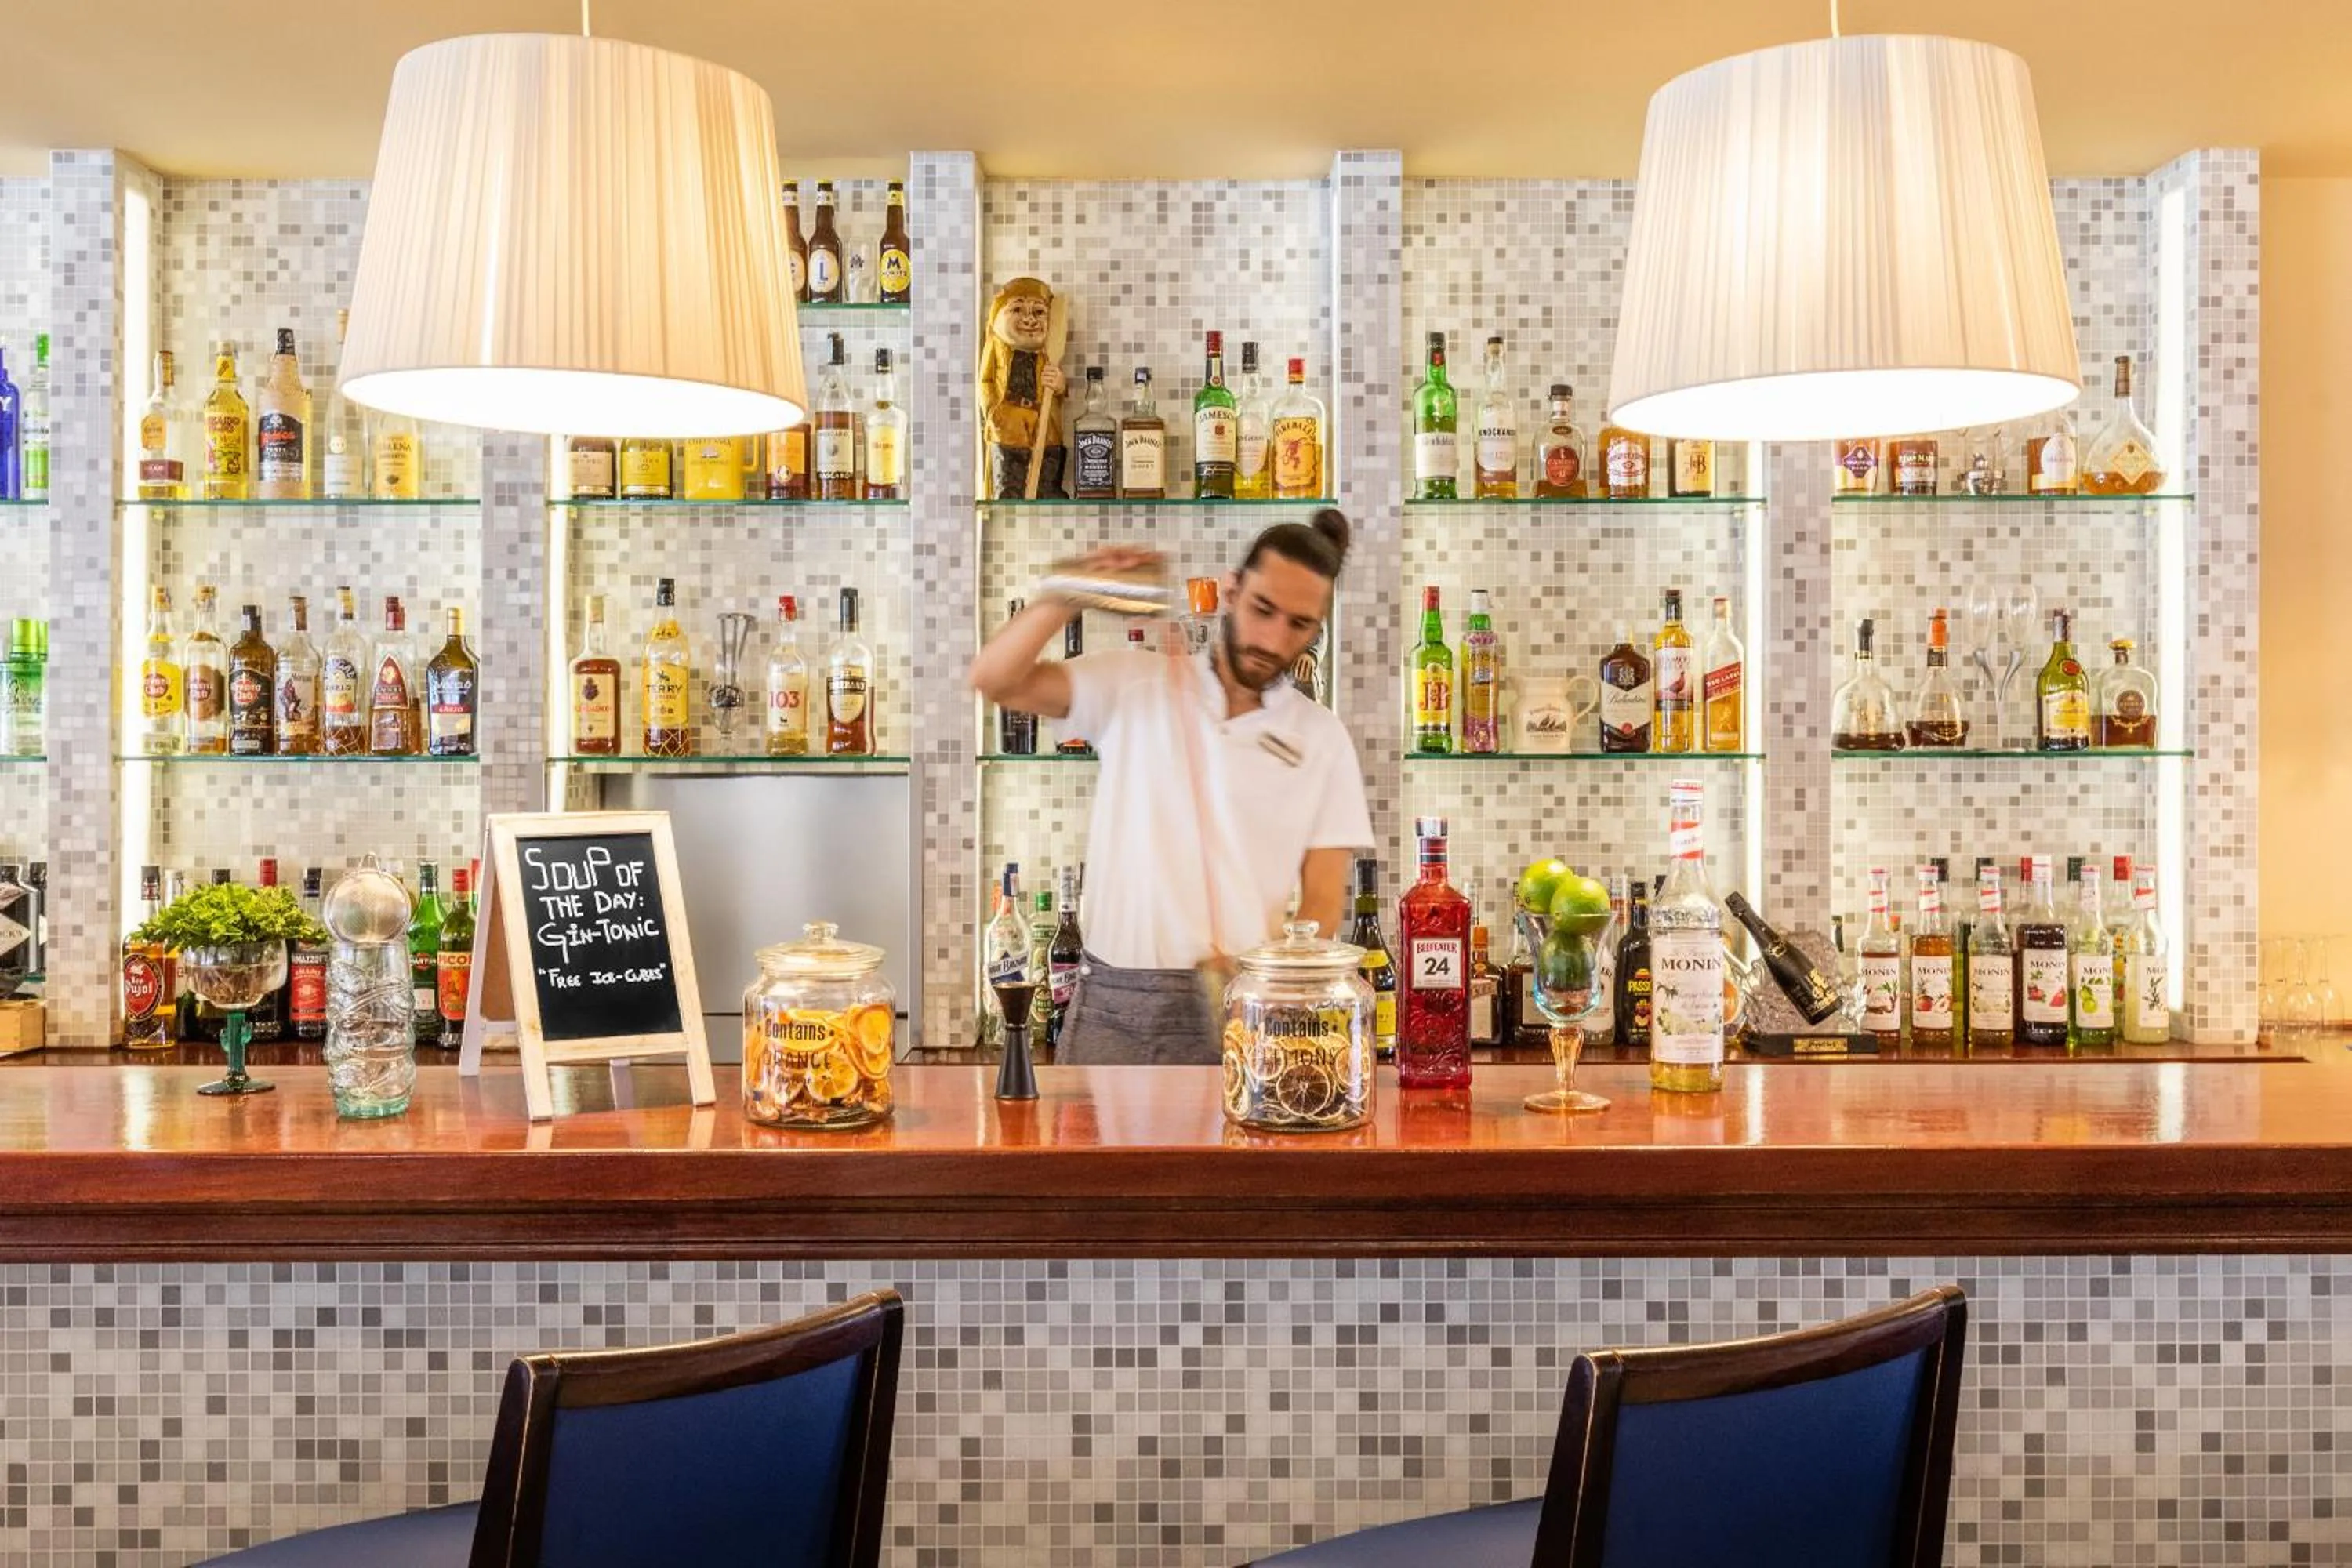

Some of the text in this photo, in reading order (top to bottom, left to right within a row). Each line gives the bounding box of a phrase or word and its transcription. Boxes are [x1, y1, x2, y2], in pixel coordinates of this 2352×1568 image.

[887, 256, 901, 269] M
[1198, 408, 1236, 424] JAMESO
[645, 684, 682, 694] TERRY
[768, 691, 799, 708] 103
[524, 847, 644, 891] SOUP OF
[539, 891, 644, 920] THE DAY:
[1417, 942, 1457, 954] BEEFEATER
[1424, 957, 1450, 975] 24
[1661, 957, 1722, 971] MONIN
[765, 1018, 826, 1041] Contains
[1265, 1018, 1330, 1038] Contains
